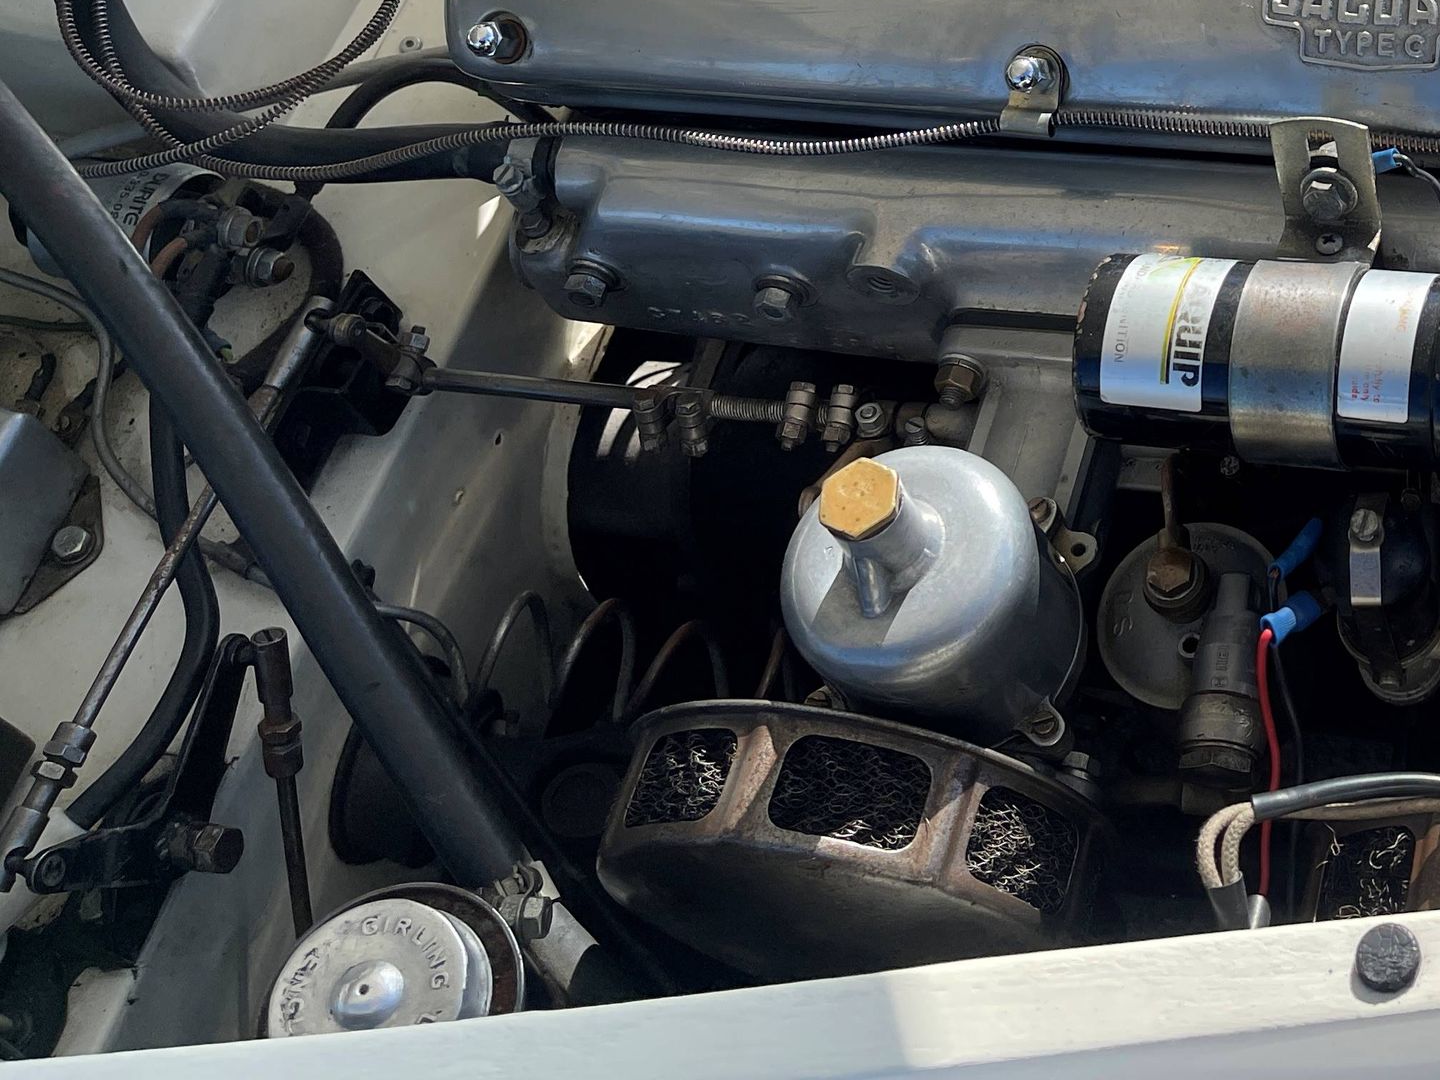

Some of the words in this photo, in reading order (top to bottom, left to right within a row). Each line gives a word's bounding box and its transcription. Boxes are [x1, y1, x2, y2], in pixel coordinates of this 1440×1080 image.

[1314, 28, 1396, 57] TYPE
[1404, 34, 1426, 58] C
[123, 172, 170, 226] DURITE
[361, 914, 449, 991] GIRLING
